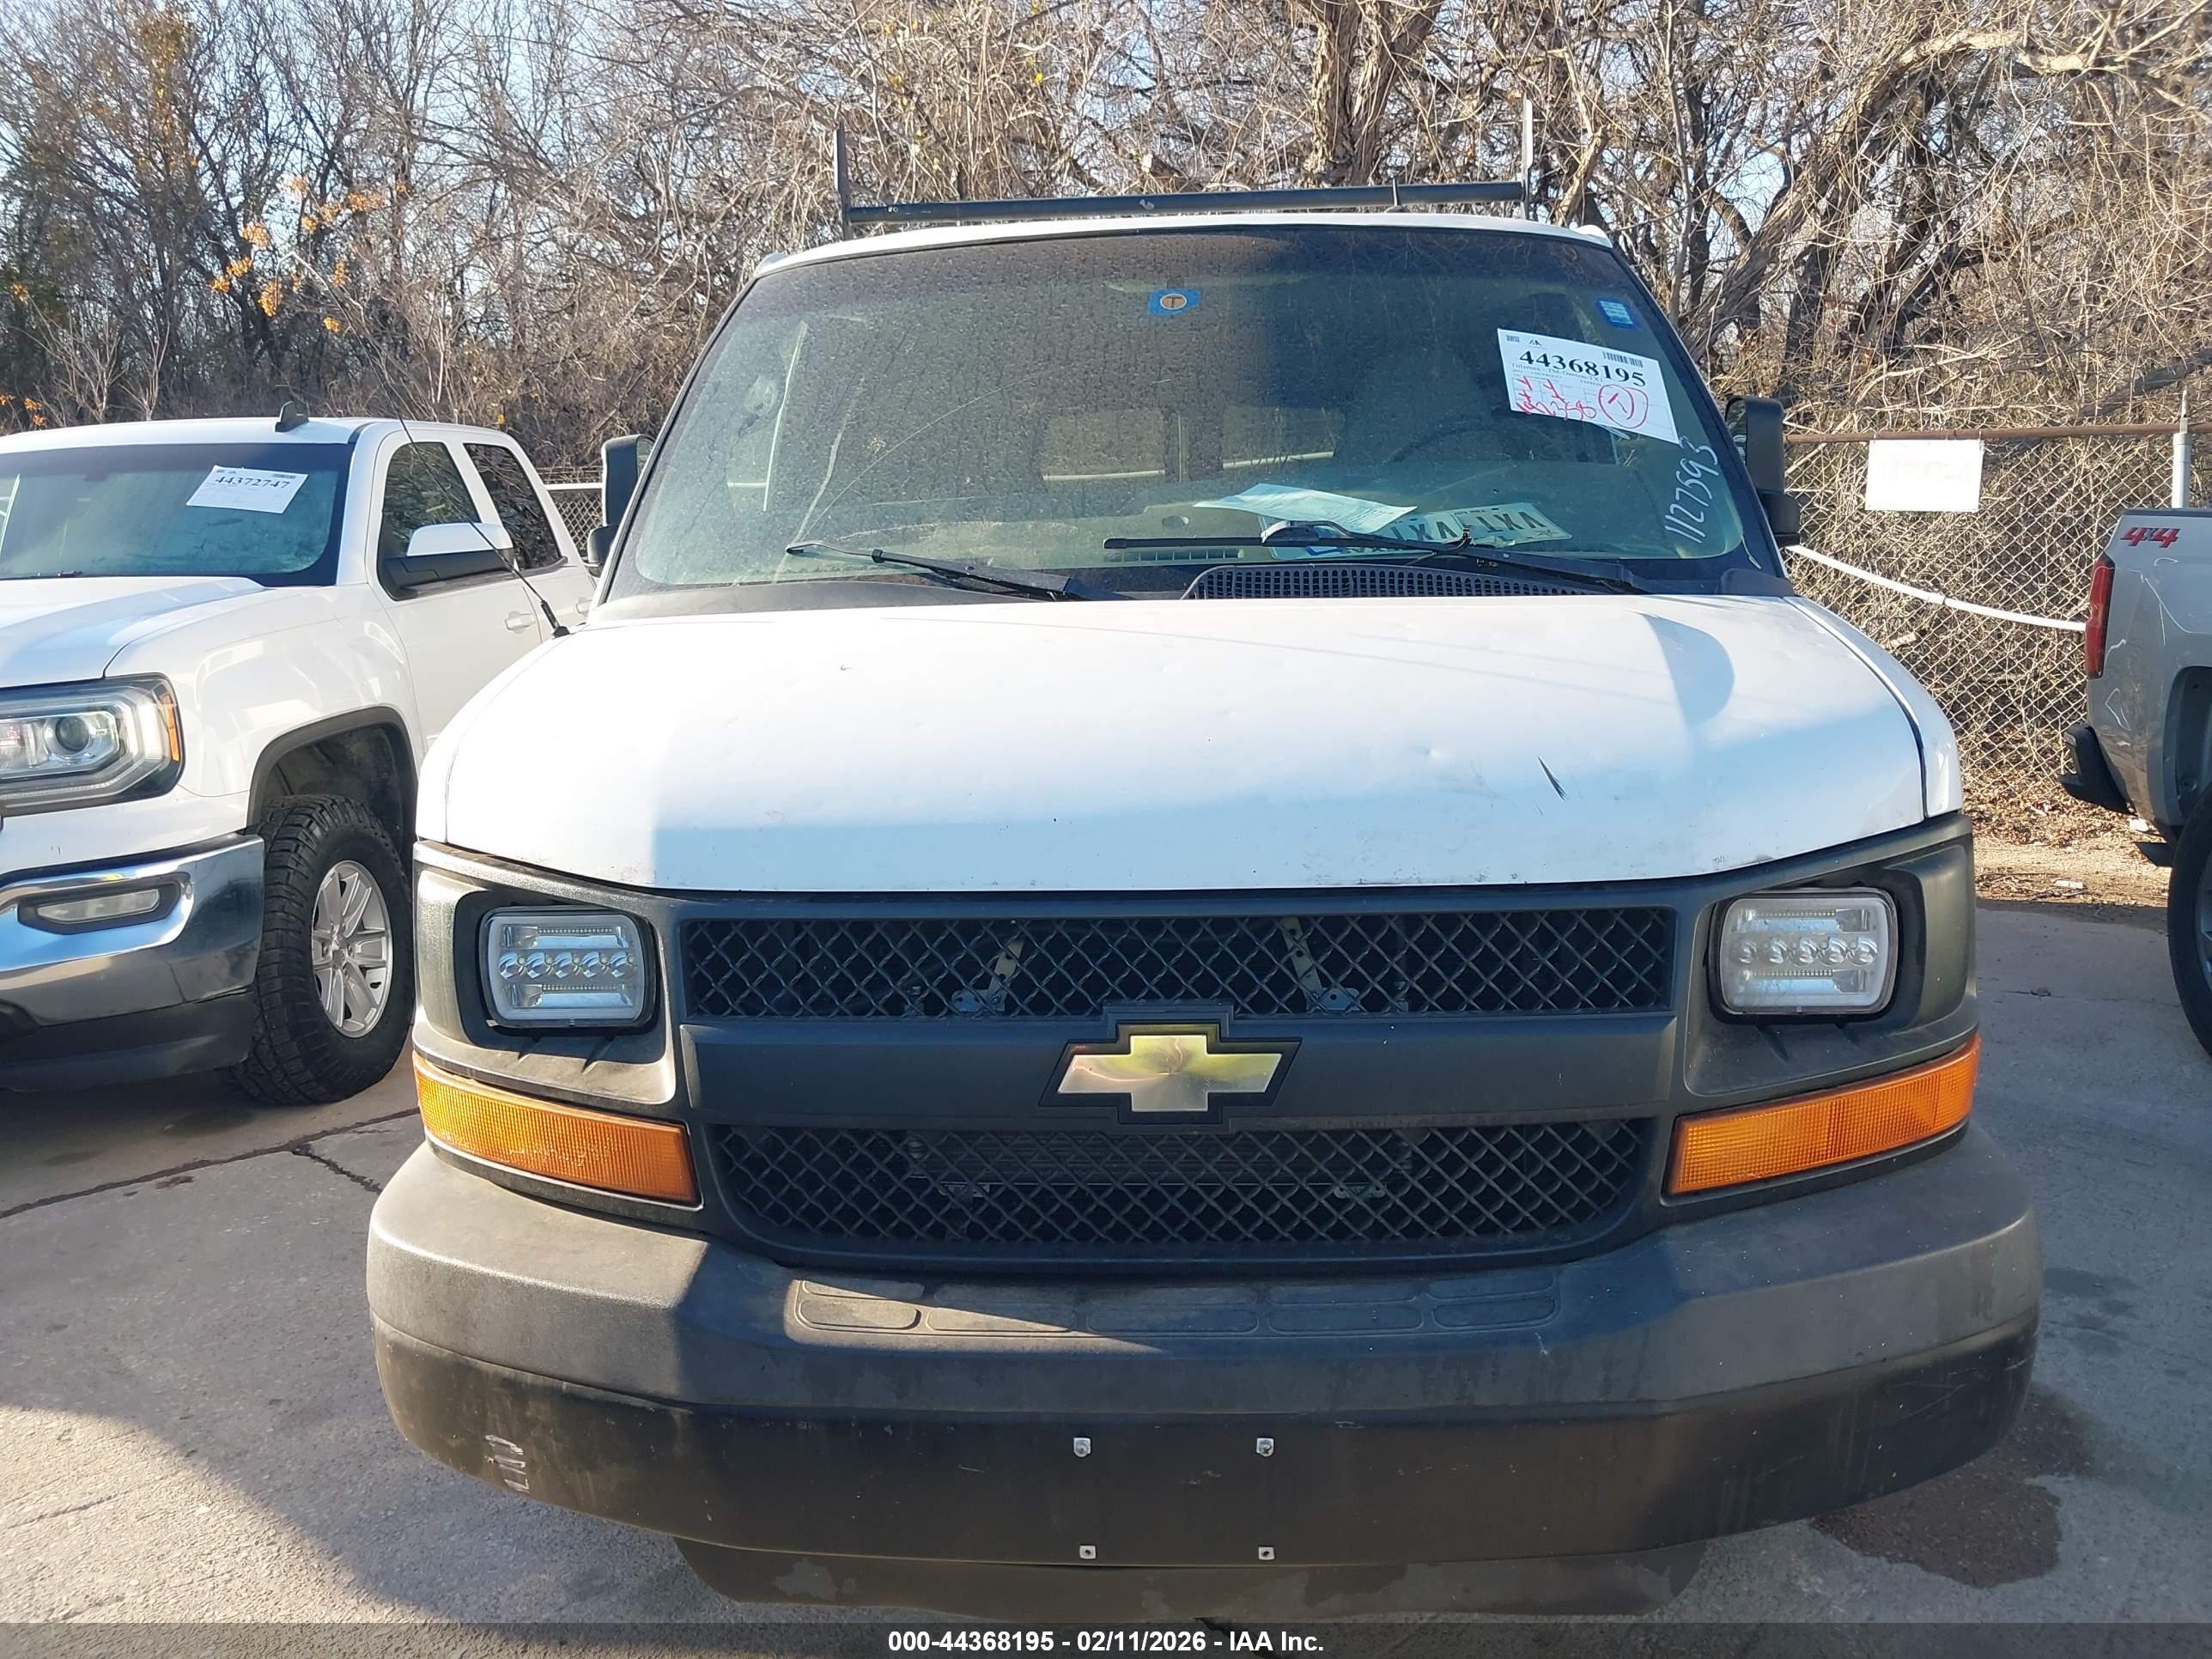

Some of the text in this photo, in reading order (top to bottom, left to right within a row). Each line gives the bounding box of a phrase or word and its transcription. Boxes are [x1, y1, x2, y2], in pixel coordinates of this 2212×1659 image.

[1519, 350, 1646, 386] 44368195
[215, 476, 290, 489] 44372747
[1664, 434, 1719, 544] 1127593
